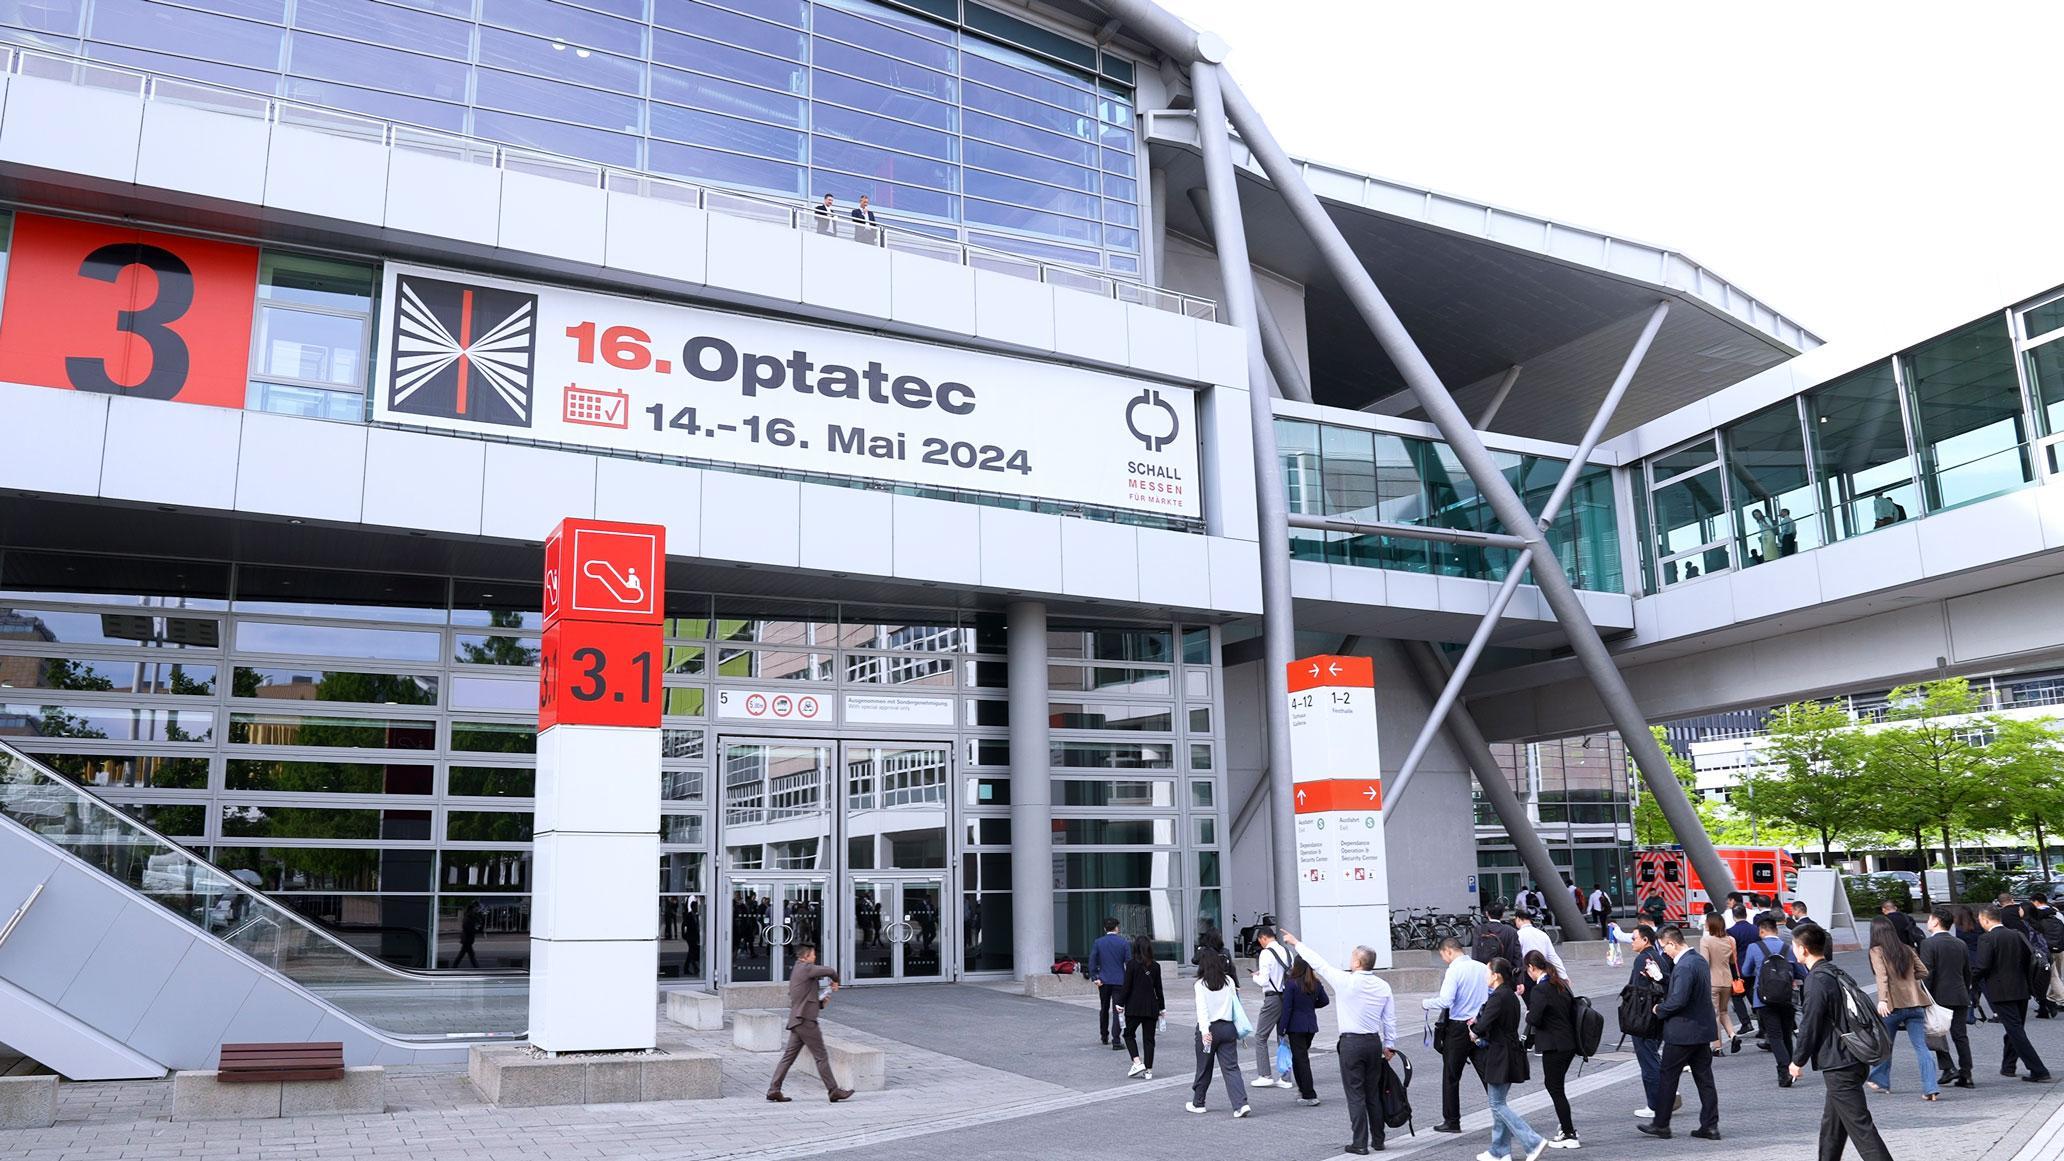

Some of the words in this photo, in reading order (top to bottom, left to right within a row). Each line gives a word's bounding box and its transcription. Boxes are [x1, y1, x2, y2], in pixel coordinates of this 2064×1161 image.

[65, 243, 195, 401] 3
[565, 321, 671, 374] 16.
[682, 335, 976, 415] Optatec
[827, 425, 905, 460] Mai
[922, 437, 1032, 476] 2024
[1127, 461, 1182, 480] SCHALL
[1128, 479, 1182, 495] MESSEN
[541, 648, 557, 708] 3.1
[571, 647, 651, 704] 3.1
[720, 692, 728, 704] 5
[1291, 694, 1313, 709] 4-12
[1331, 691, 1351, 705] 1-2
